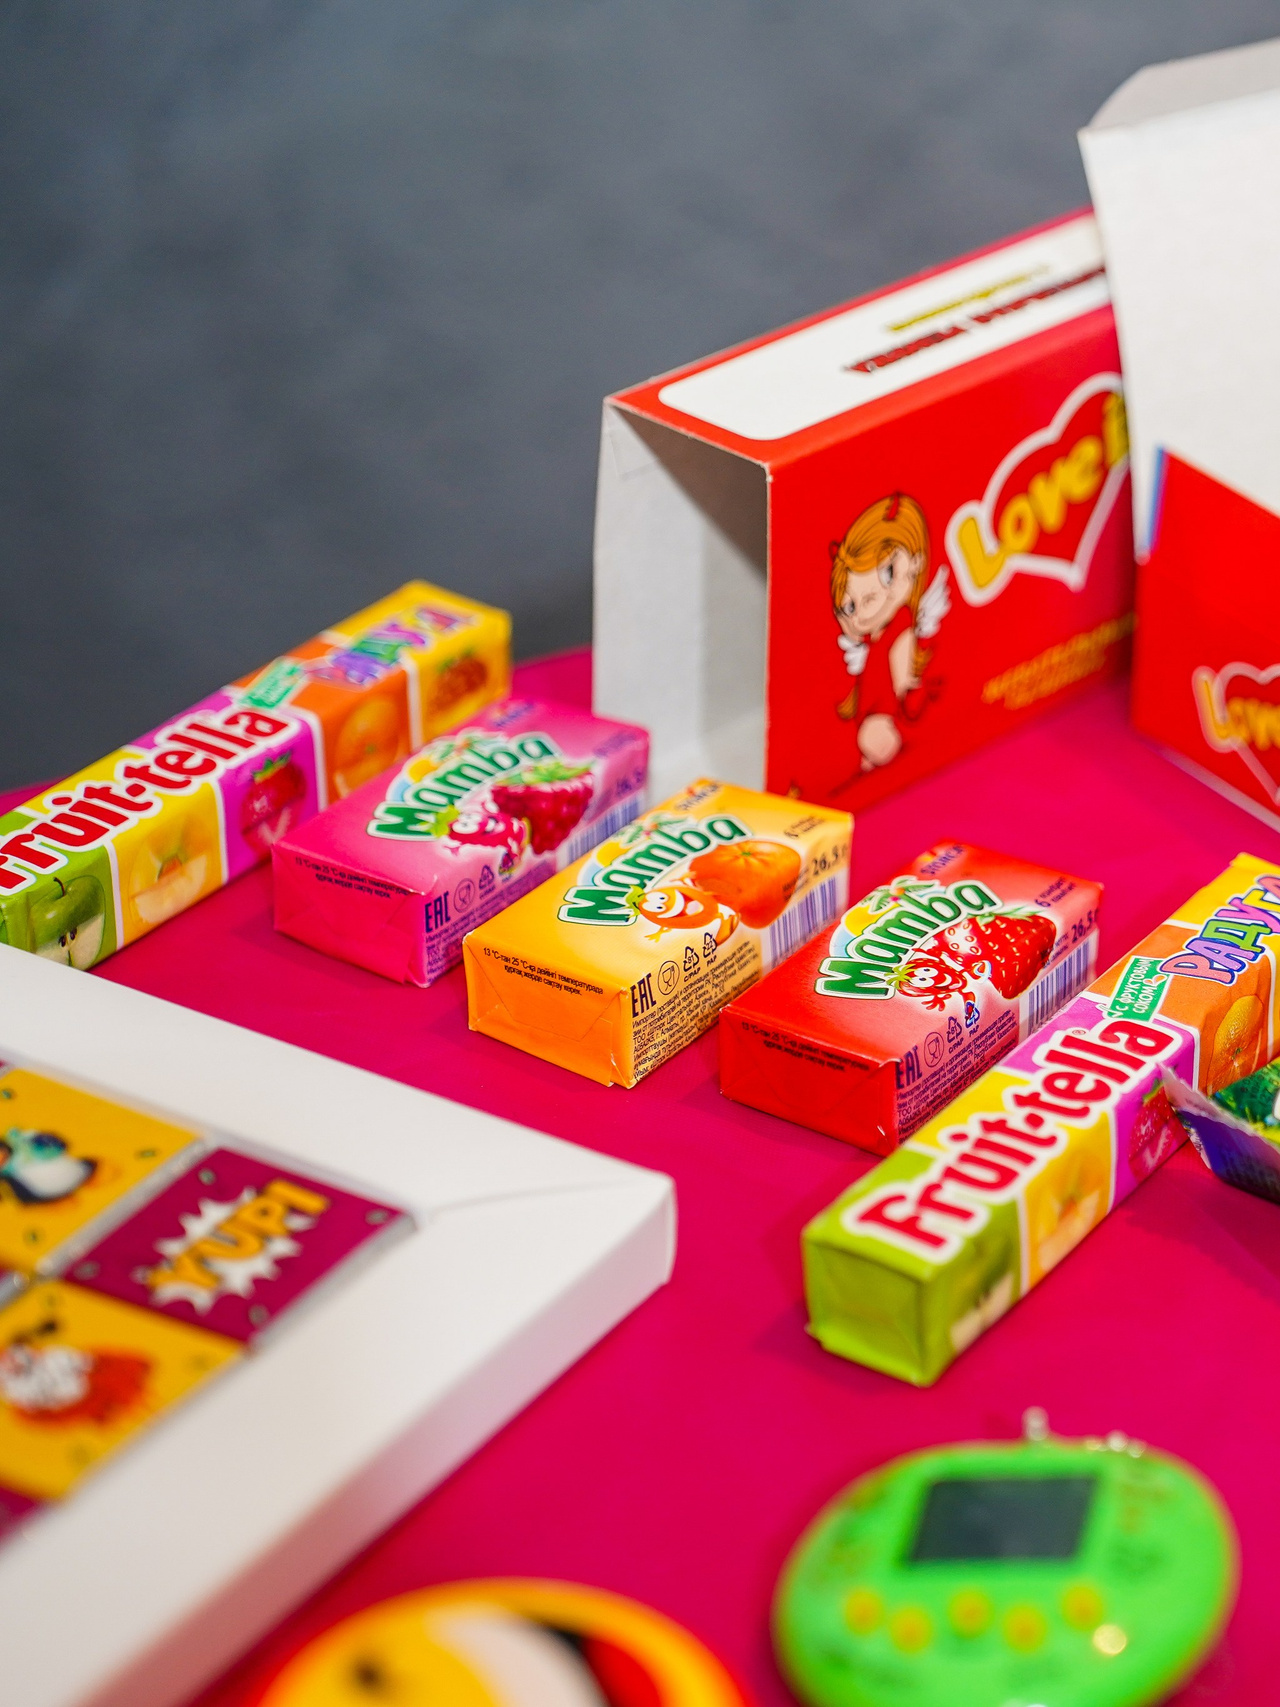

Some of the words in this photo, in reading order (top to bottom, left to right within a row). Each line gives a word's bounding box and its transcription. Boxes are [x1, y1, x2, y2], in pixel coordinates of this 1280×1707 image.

[957, 437, 1104, 590] Love
[367, 735, 556, 840] Mamba
[563, 815, 749, 926] Mamba
[818, 882, 999, 998] Mamba
[1115, 957, 1154, 1003] ФРУКТОВЫМ
[629, 972, 658, 1019] EAC
[1132, 985, 1157, 1013] СОКОМ
